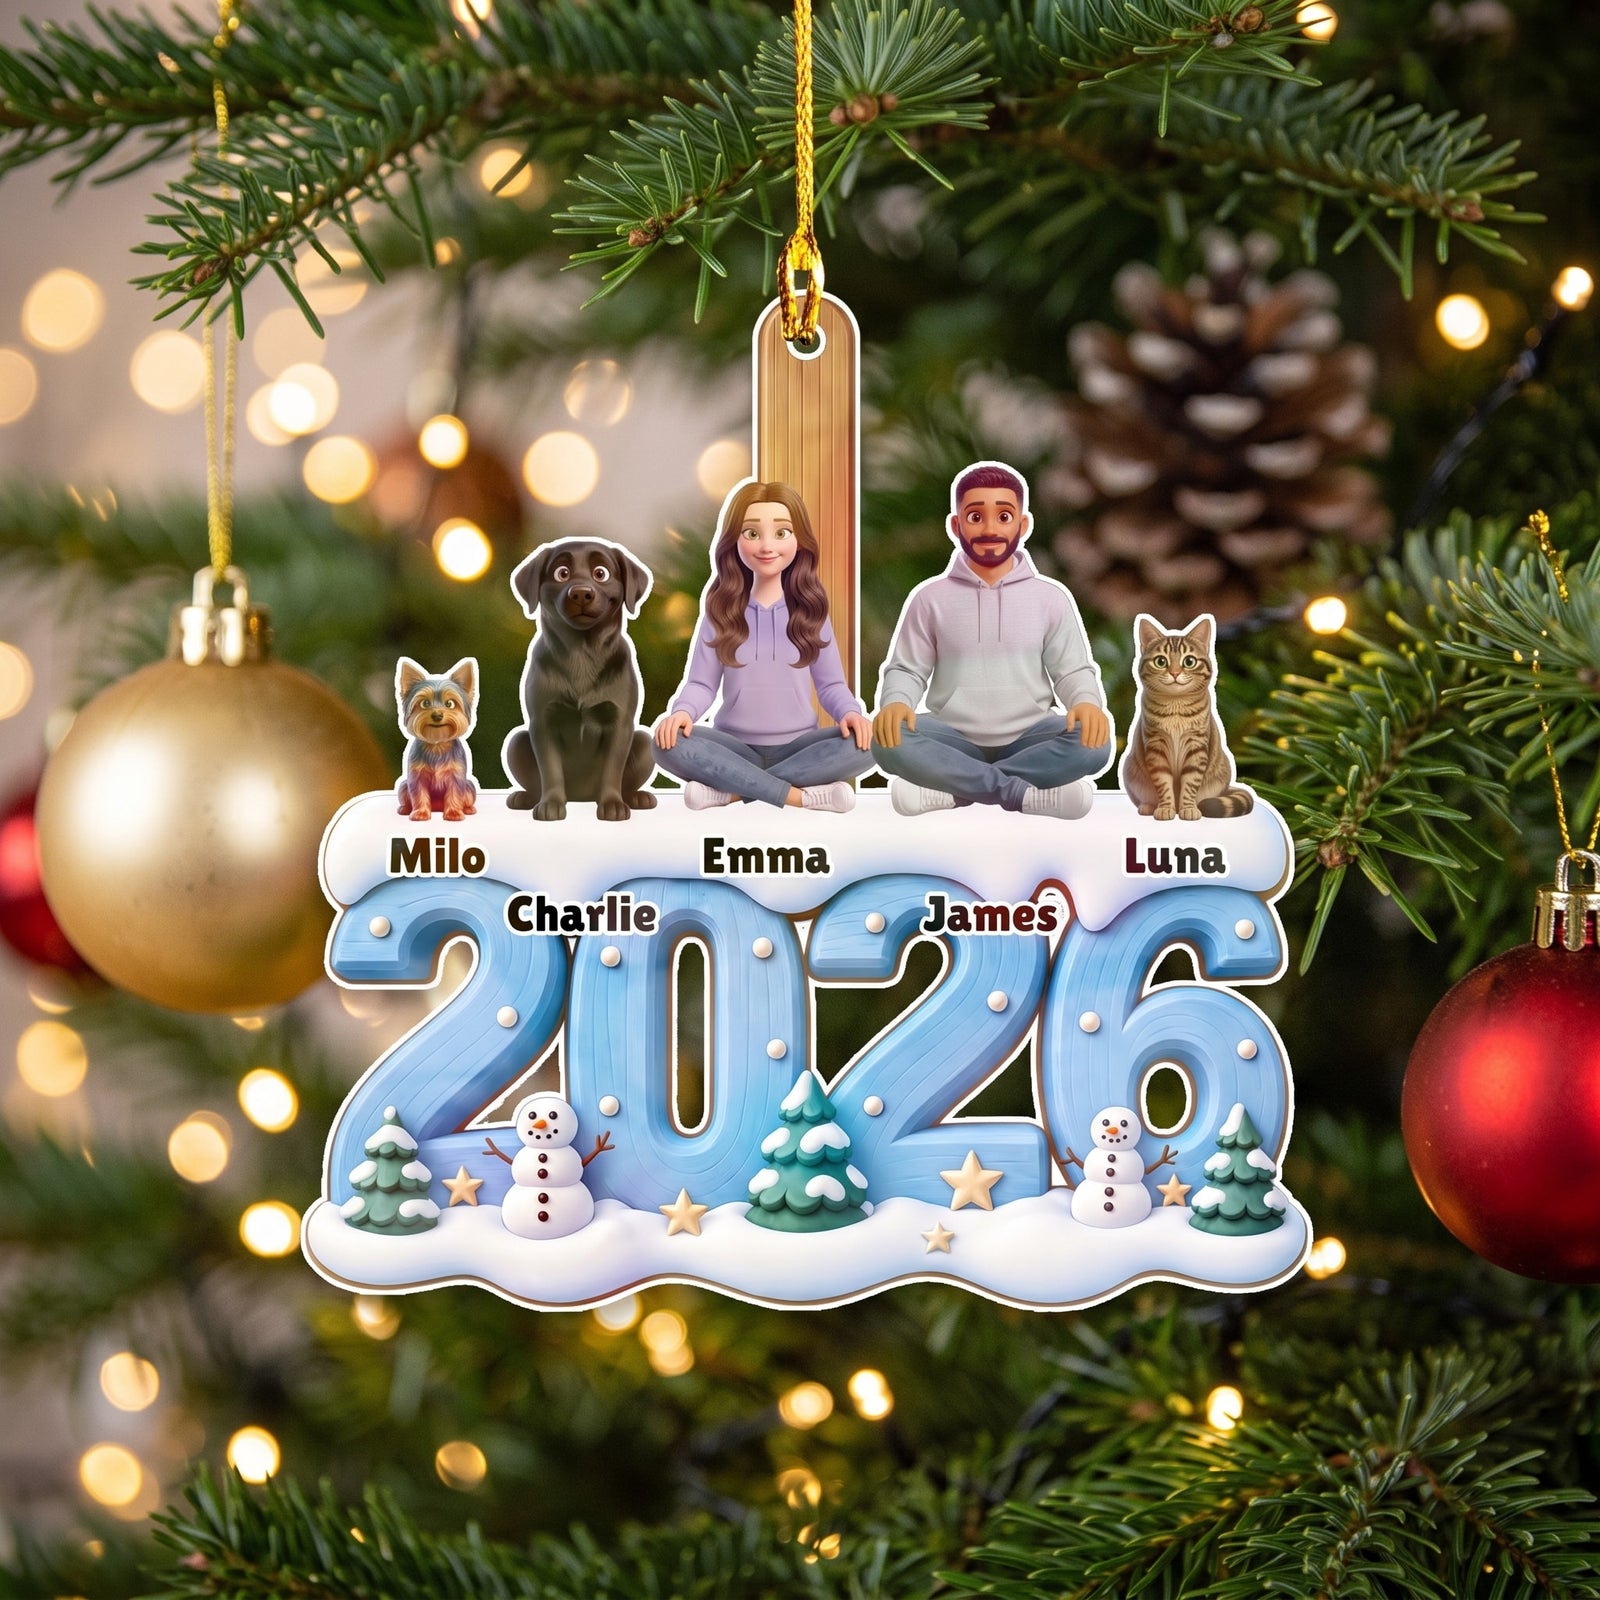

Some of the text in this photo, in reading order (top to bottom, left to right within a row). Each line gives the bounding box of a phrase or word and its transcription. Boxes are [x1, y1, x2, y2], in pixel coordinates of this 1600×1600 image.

[390, 837, 486, 875] Milo
[703, 837, 830, 875] Emma
[1126, 837, 1226, 875] Luna
[507, 895, 657, 932] Charlie
[923, 895, 1058, 932] James
[330, 874, 1290, 1212] 2026
